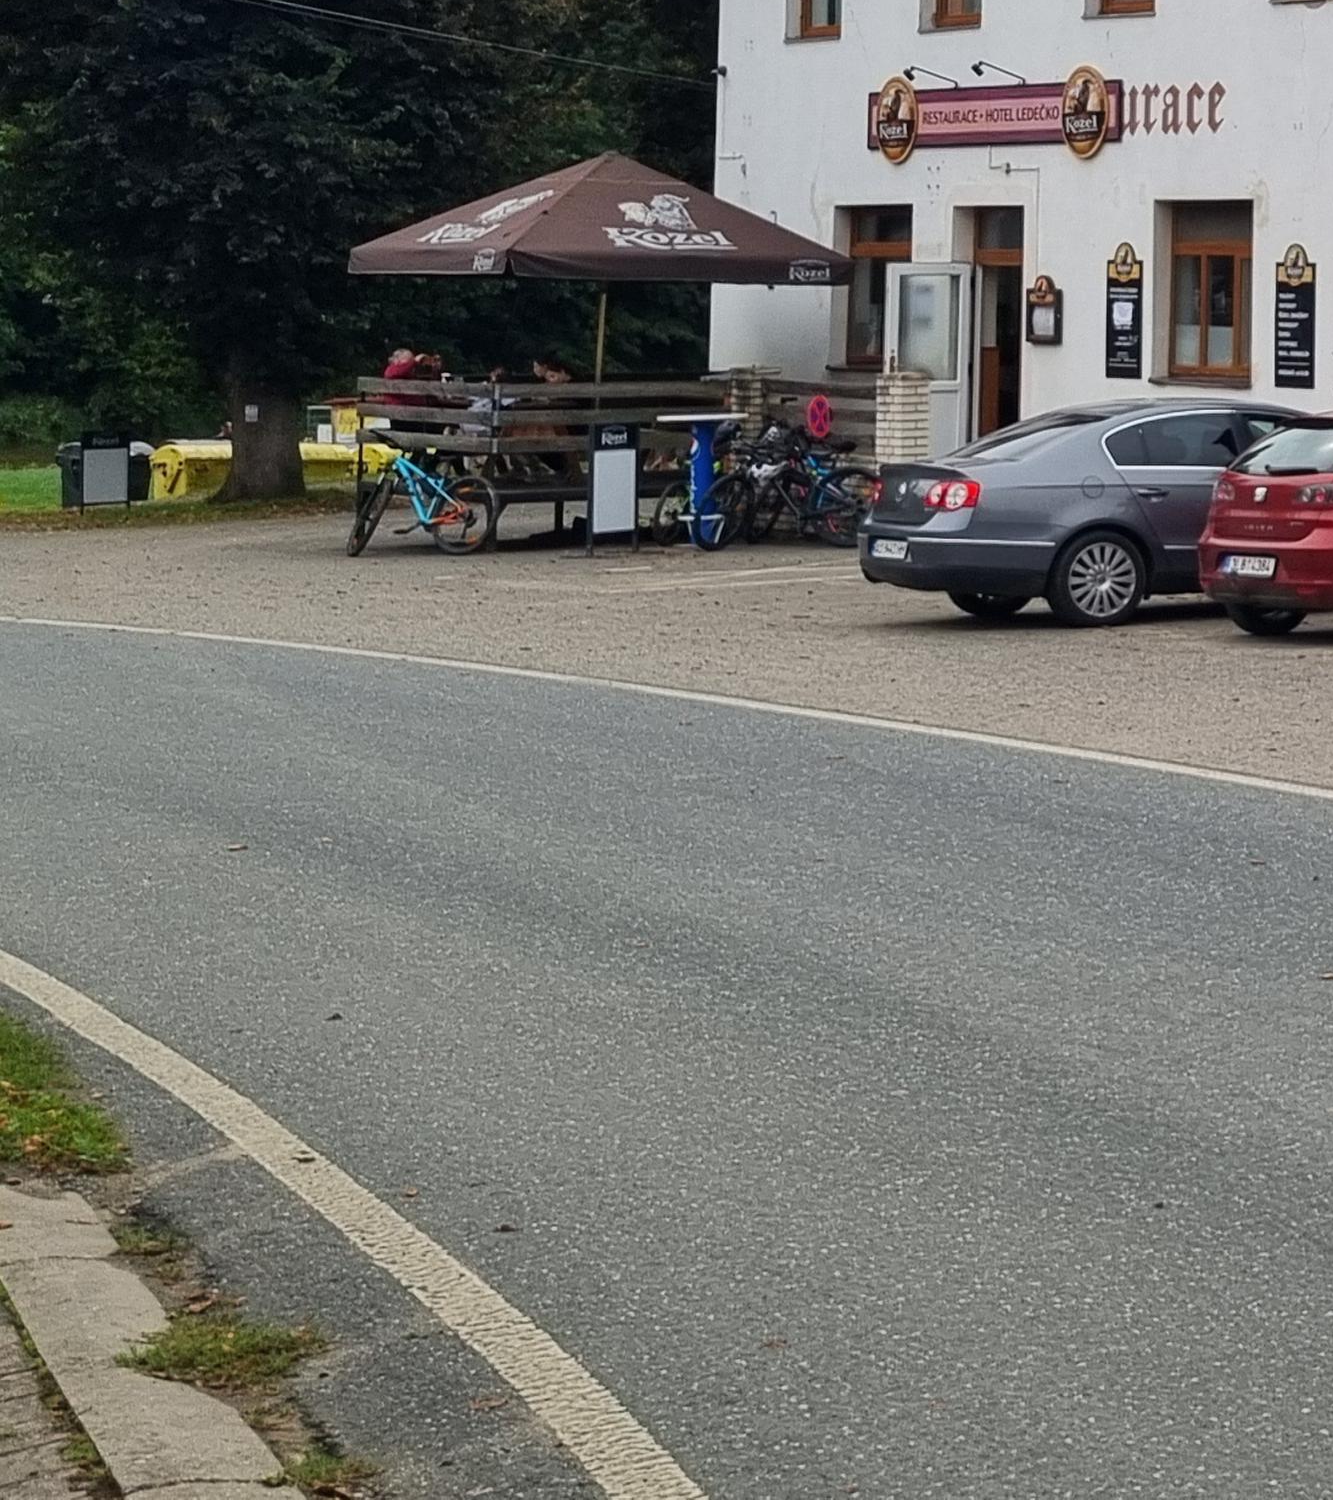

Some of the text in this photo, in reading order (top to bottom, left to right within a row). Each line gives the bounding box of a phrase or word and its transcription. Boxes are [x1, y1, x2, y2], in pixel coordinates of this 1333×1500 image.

[922, 103, 1059, 125] RESTAURACE HOTEL LEDEČKO
[1065, 114, 1099, 134] Kozel
[879, 122, 908, 140] Kozel
[602, 226, 728, 250] Kozel
[789, 266, 831, 282] Kozel
